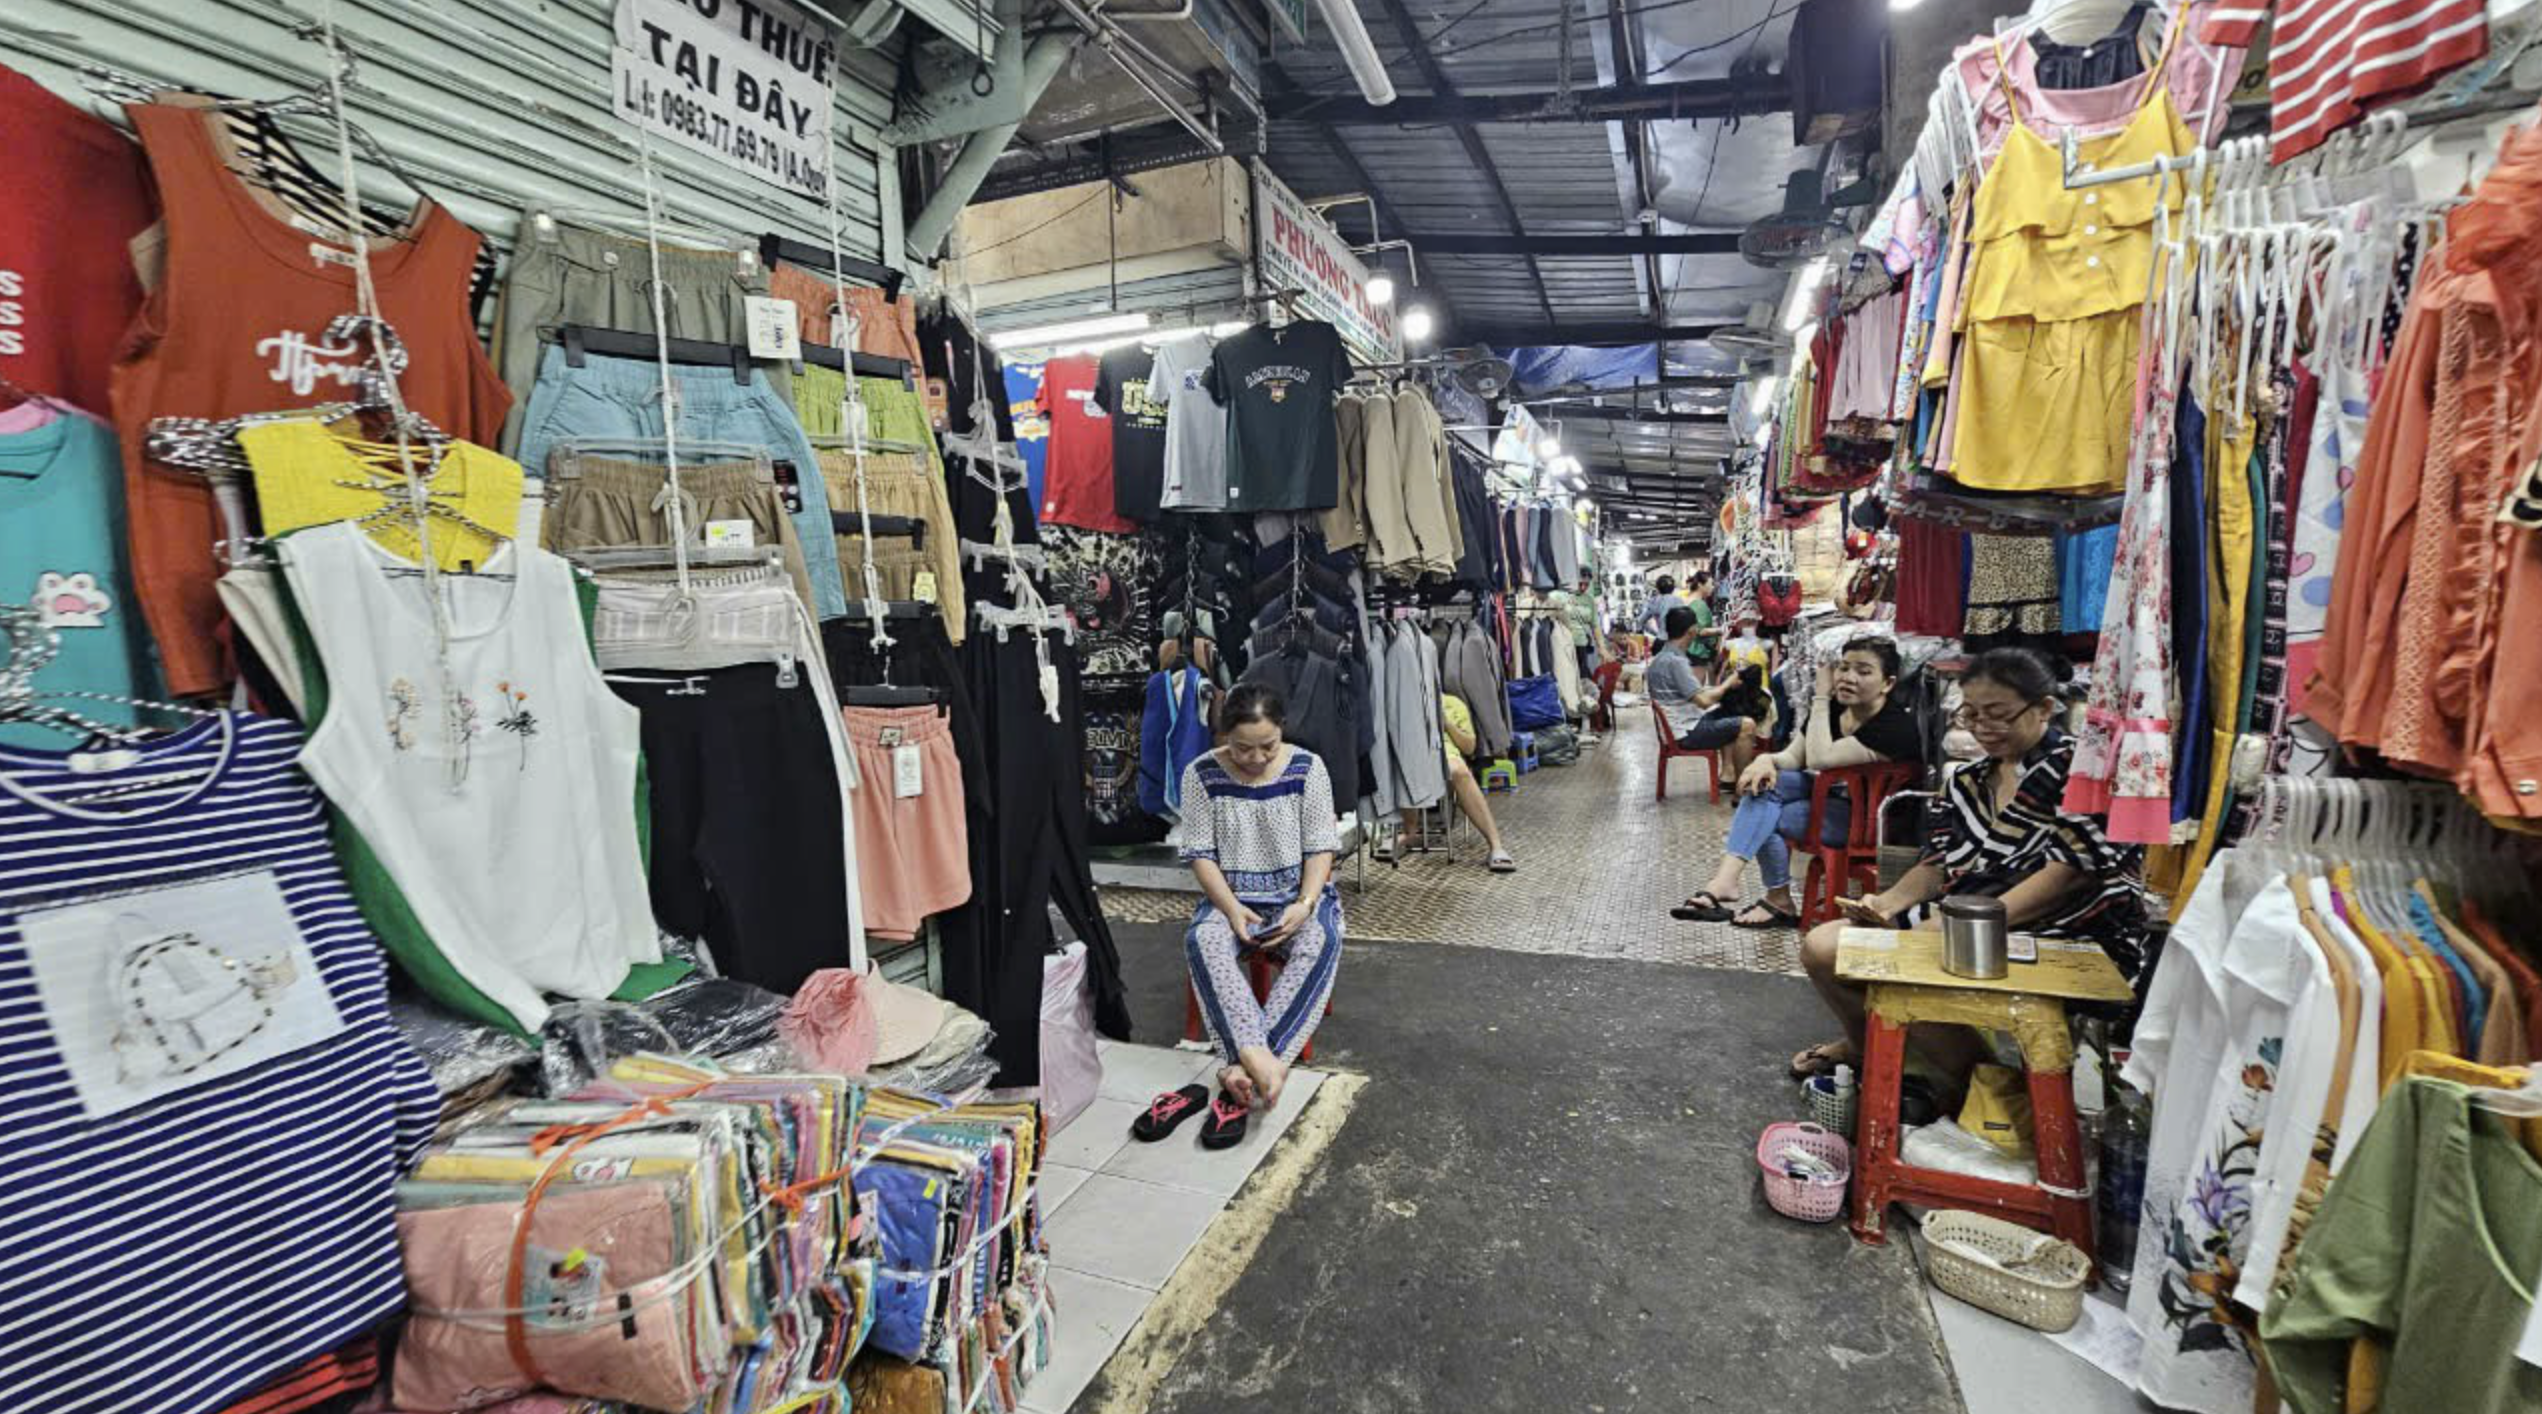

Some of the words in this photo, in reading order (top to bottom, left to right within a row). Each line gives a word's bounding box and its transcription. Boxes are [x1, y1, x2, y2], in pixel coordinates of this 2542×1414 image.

[642, 19, 720, 96] TẠI
[736, 69, 812, 140] ĐÂY
[1272, 203, 1350, 301] PHƯƠNG
